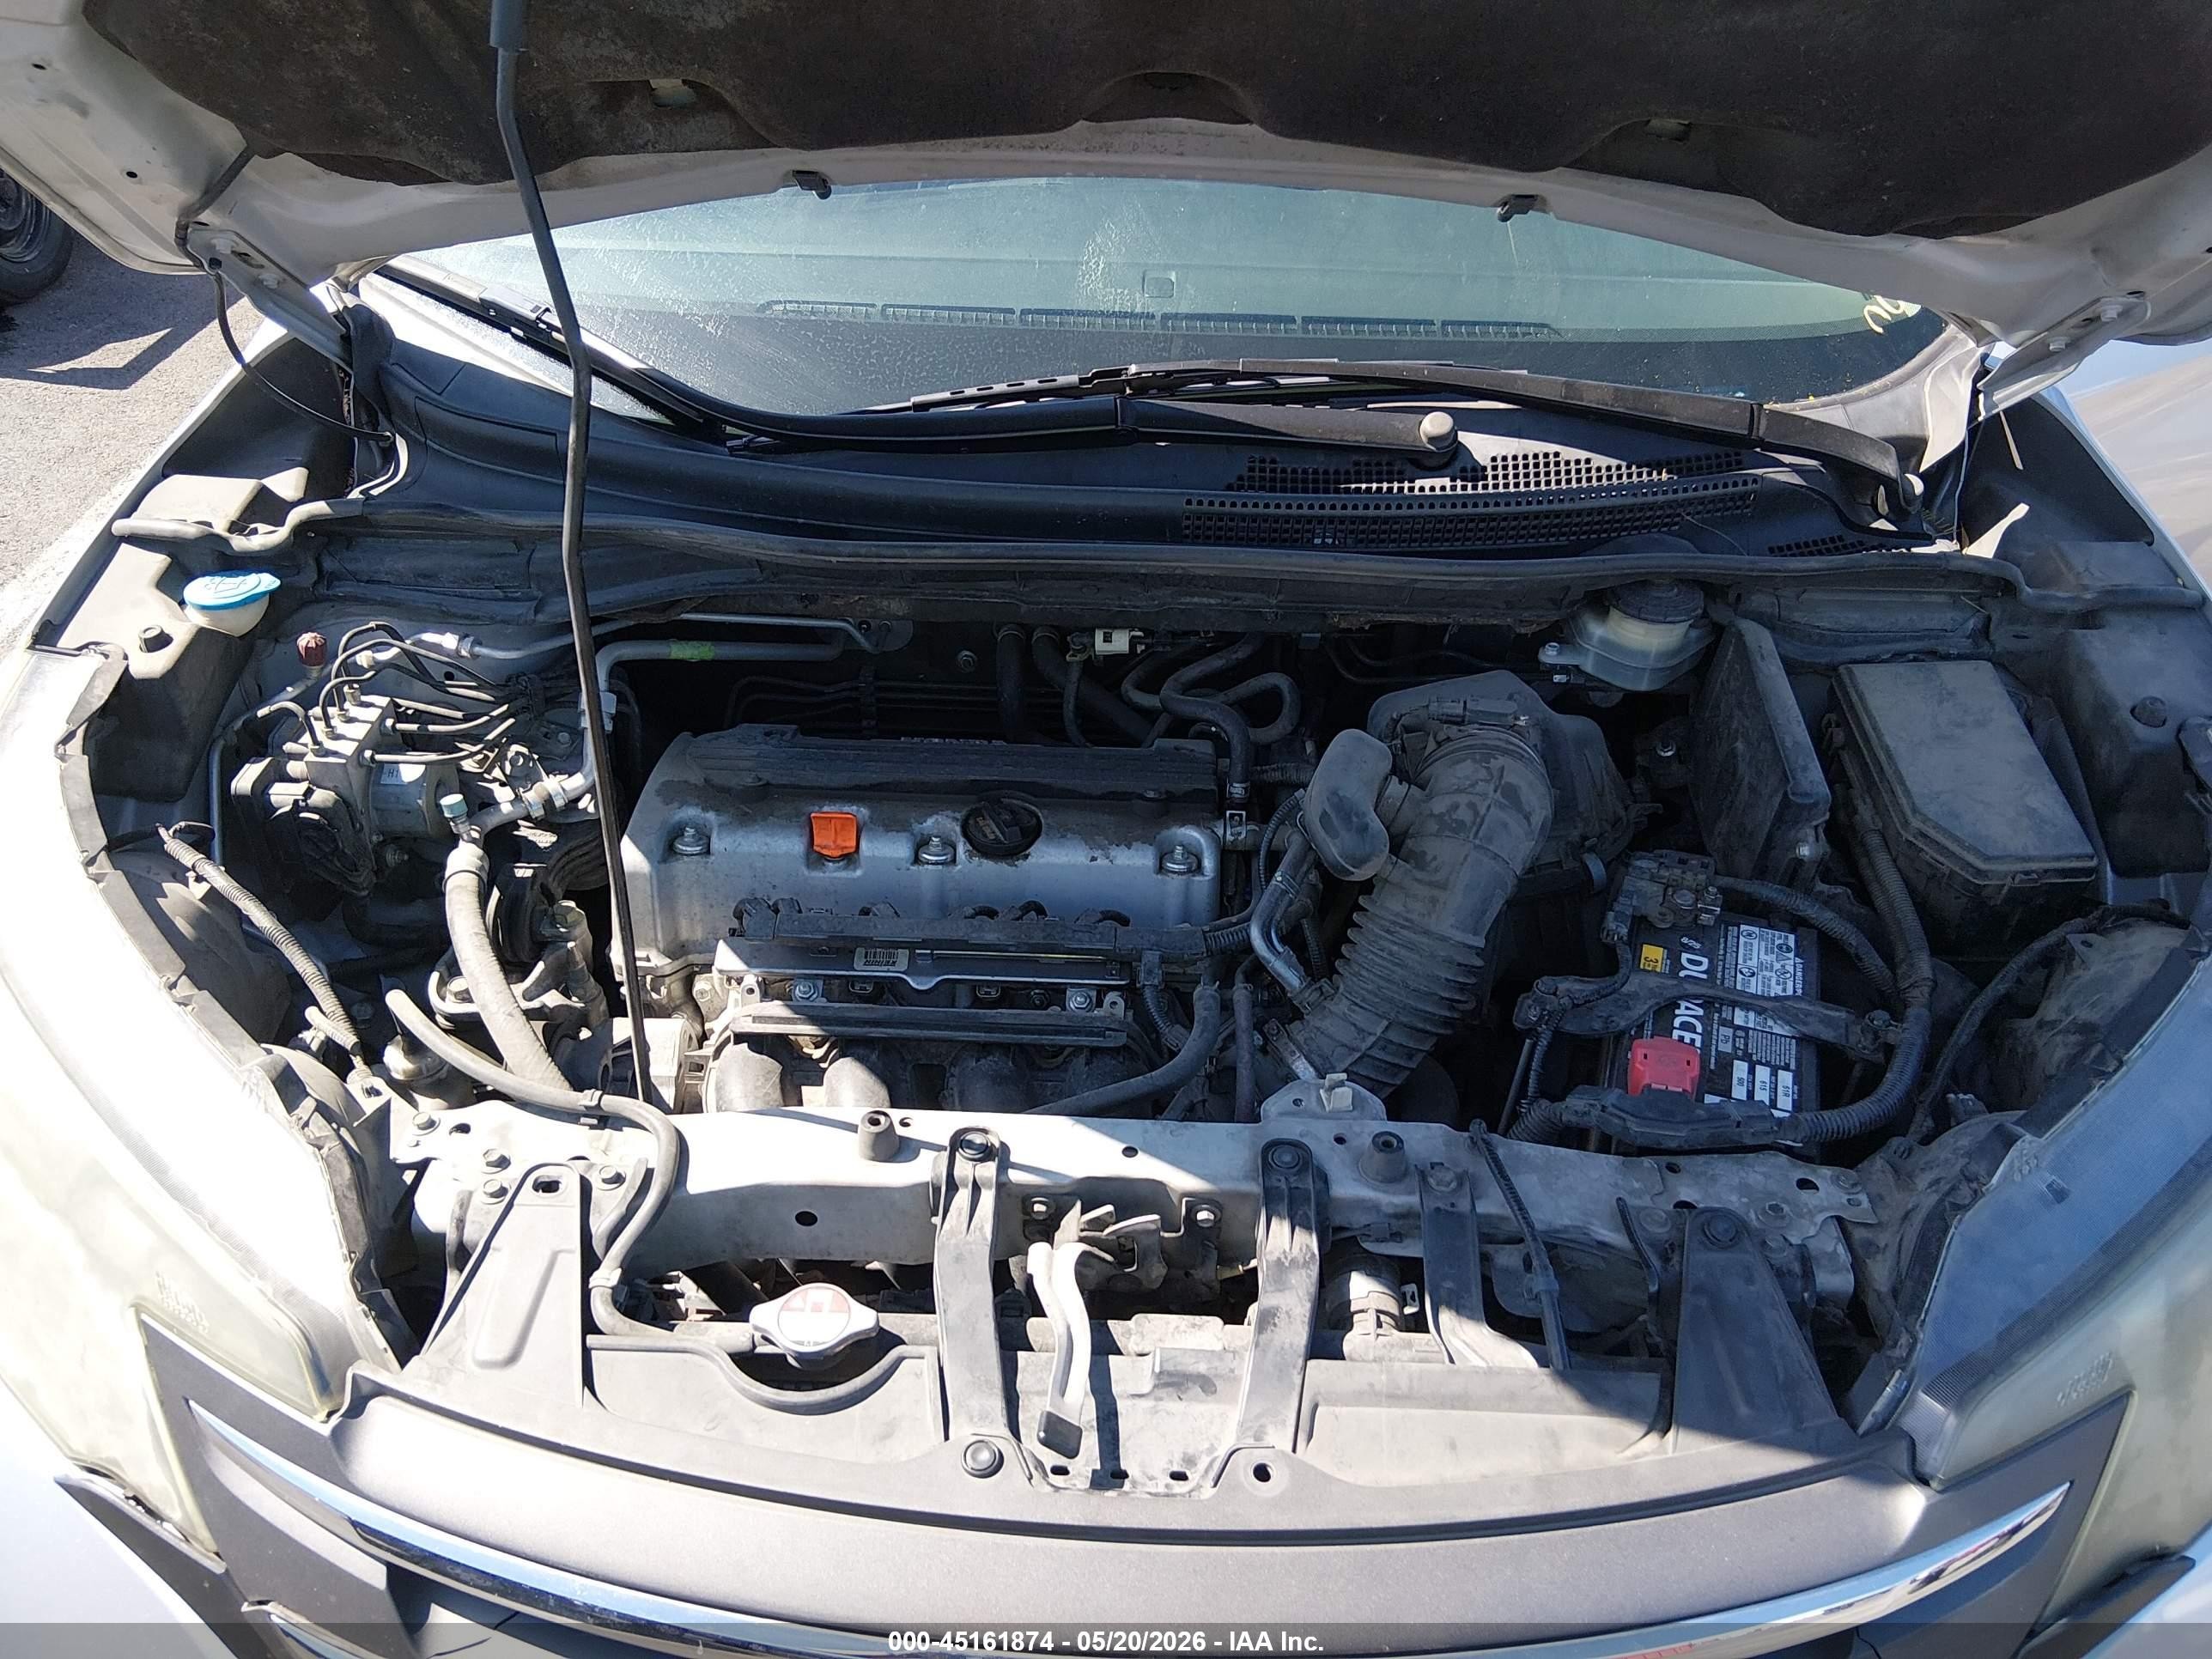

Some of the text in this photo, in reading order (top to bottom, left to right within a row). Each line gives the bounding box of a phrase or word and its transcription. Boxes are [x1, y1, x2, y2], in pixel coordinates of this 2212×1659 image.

[1721, 1034, 1730, 1044] Pb
[1736, 1076, 1746, 1087] 500
[1759, 1079, 1768, 1091] 615
